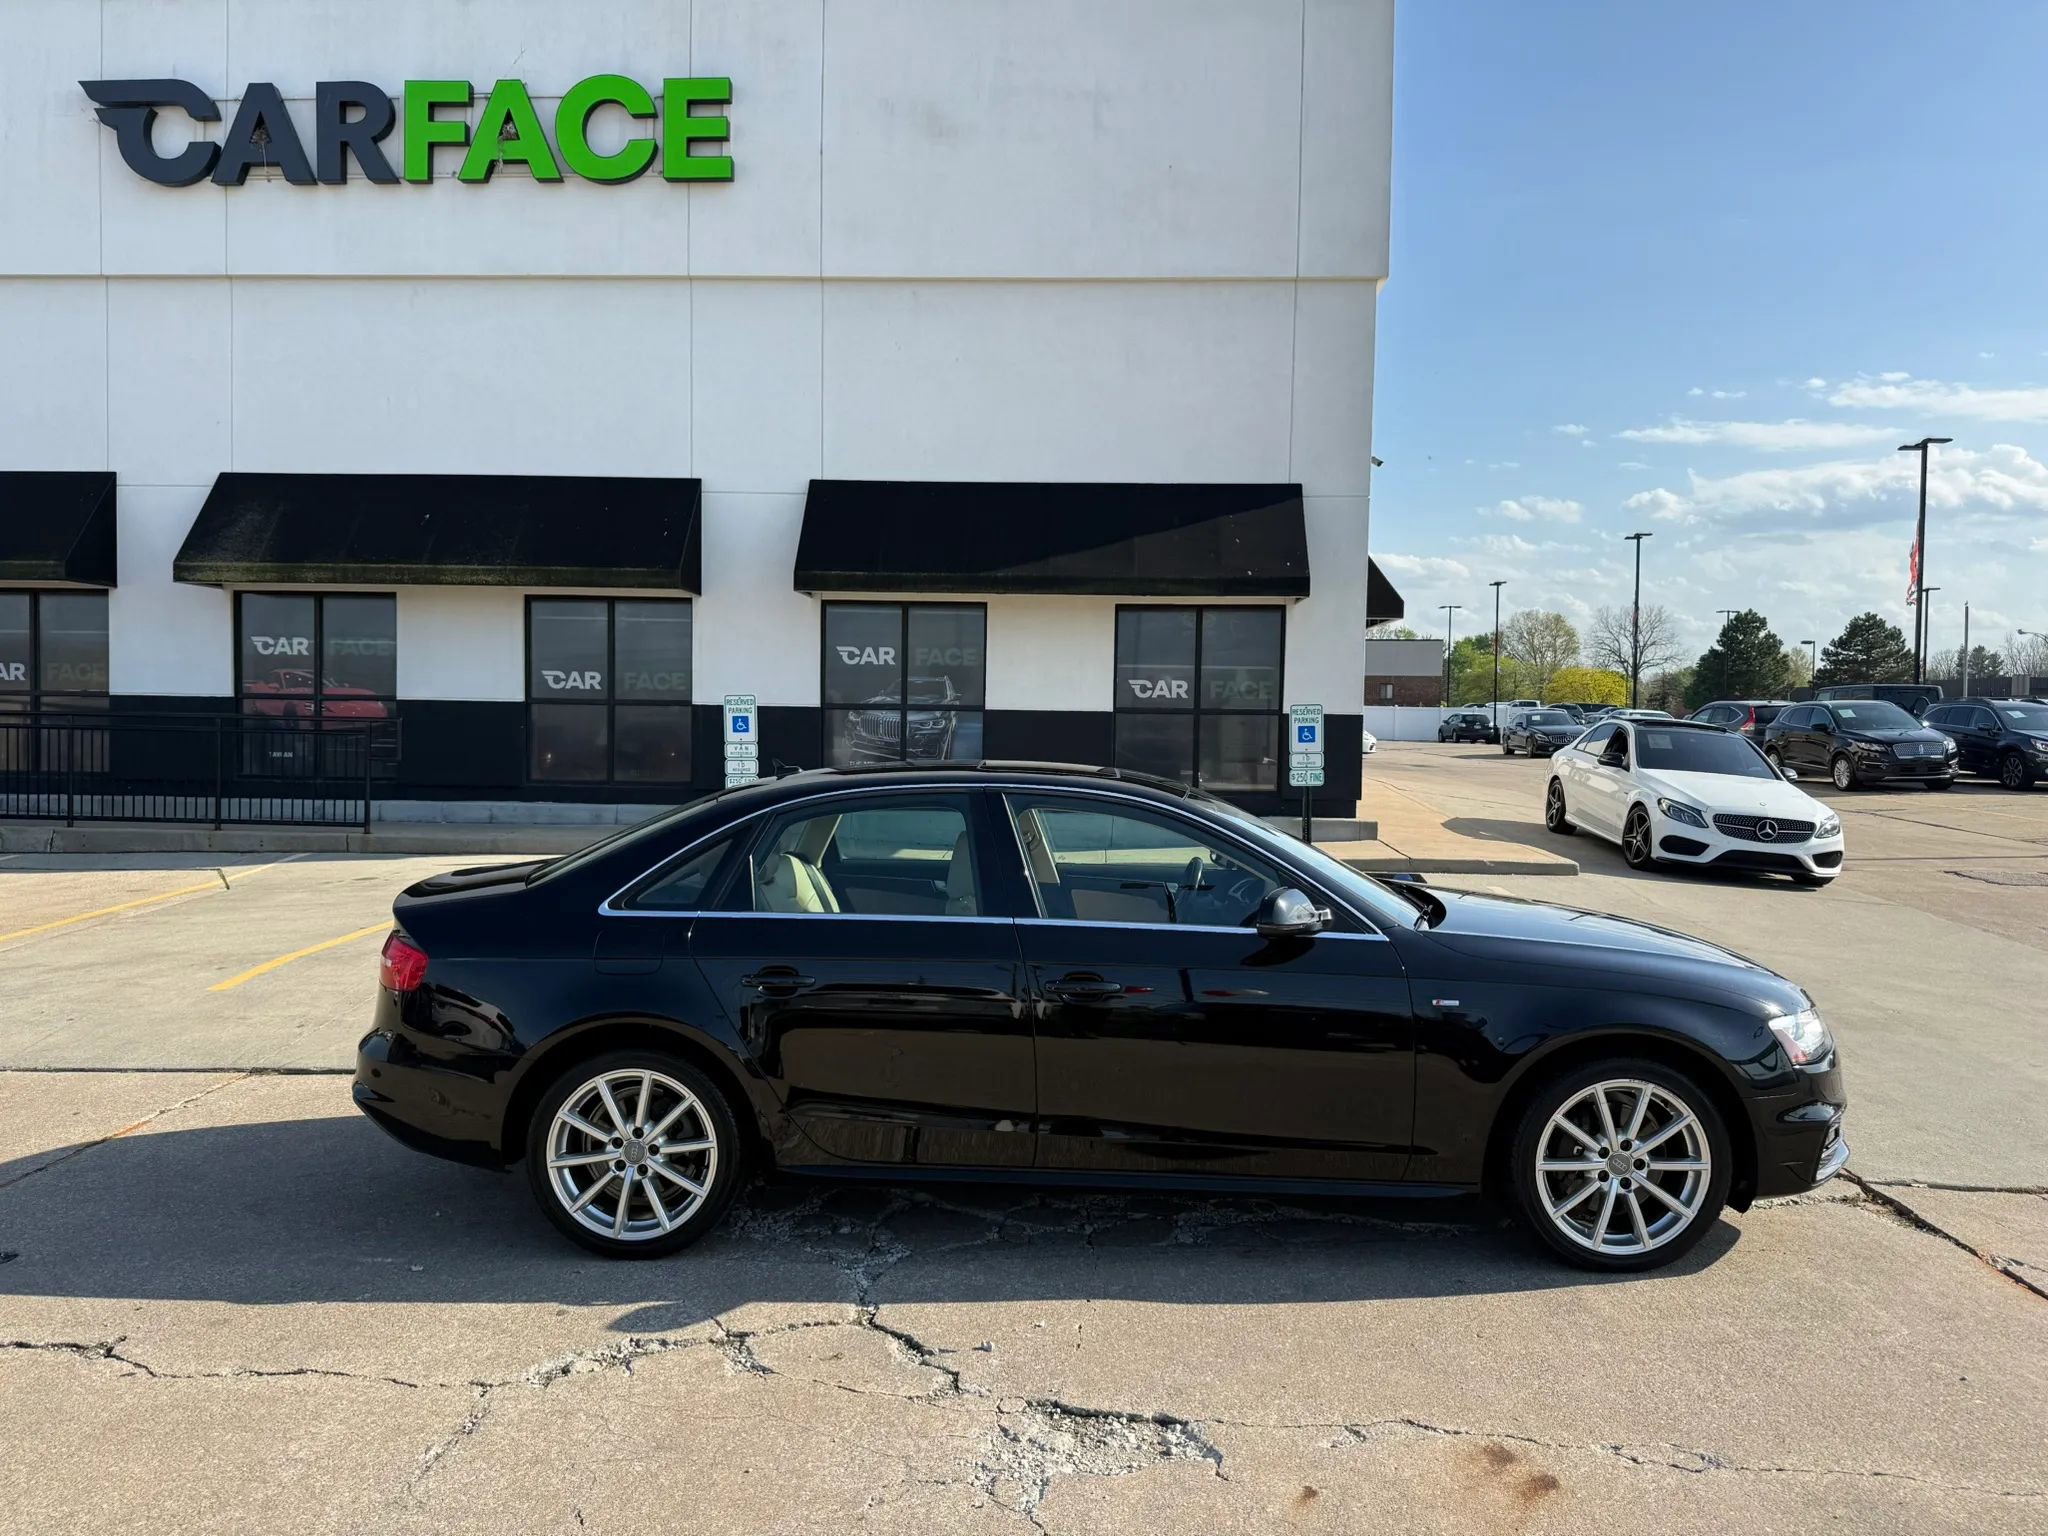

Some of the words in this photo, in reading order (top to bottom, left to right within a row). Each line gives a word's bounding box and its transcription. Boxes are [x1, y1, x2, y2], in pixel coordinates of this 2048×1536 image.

[78, 74, 735, 187] CARFACE
[250, 636, 310, 656] CAR
[836, 645, 896, 665] CAR
[541, 670, 602, 690] CAR
[1128, 679, 1189, 699] CAR
[728, 706, 753, 714] PARKING
[1292, 708, 1321, 716] RESERVED
